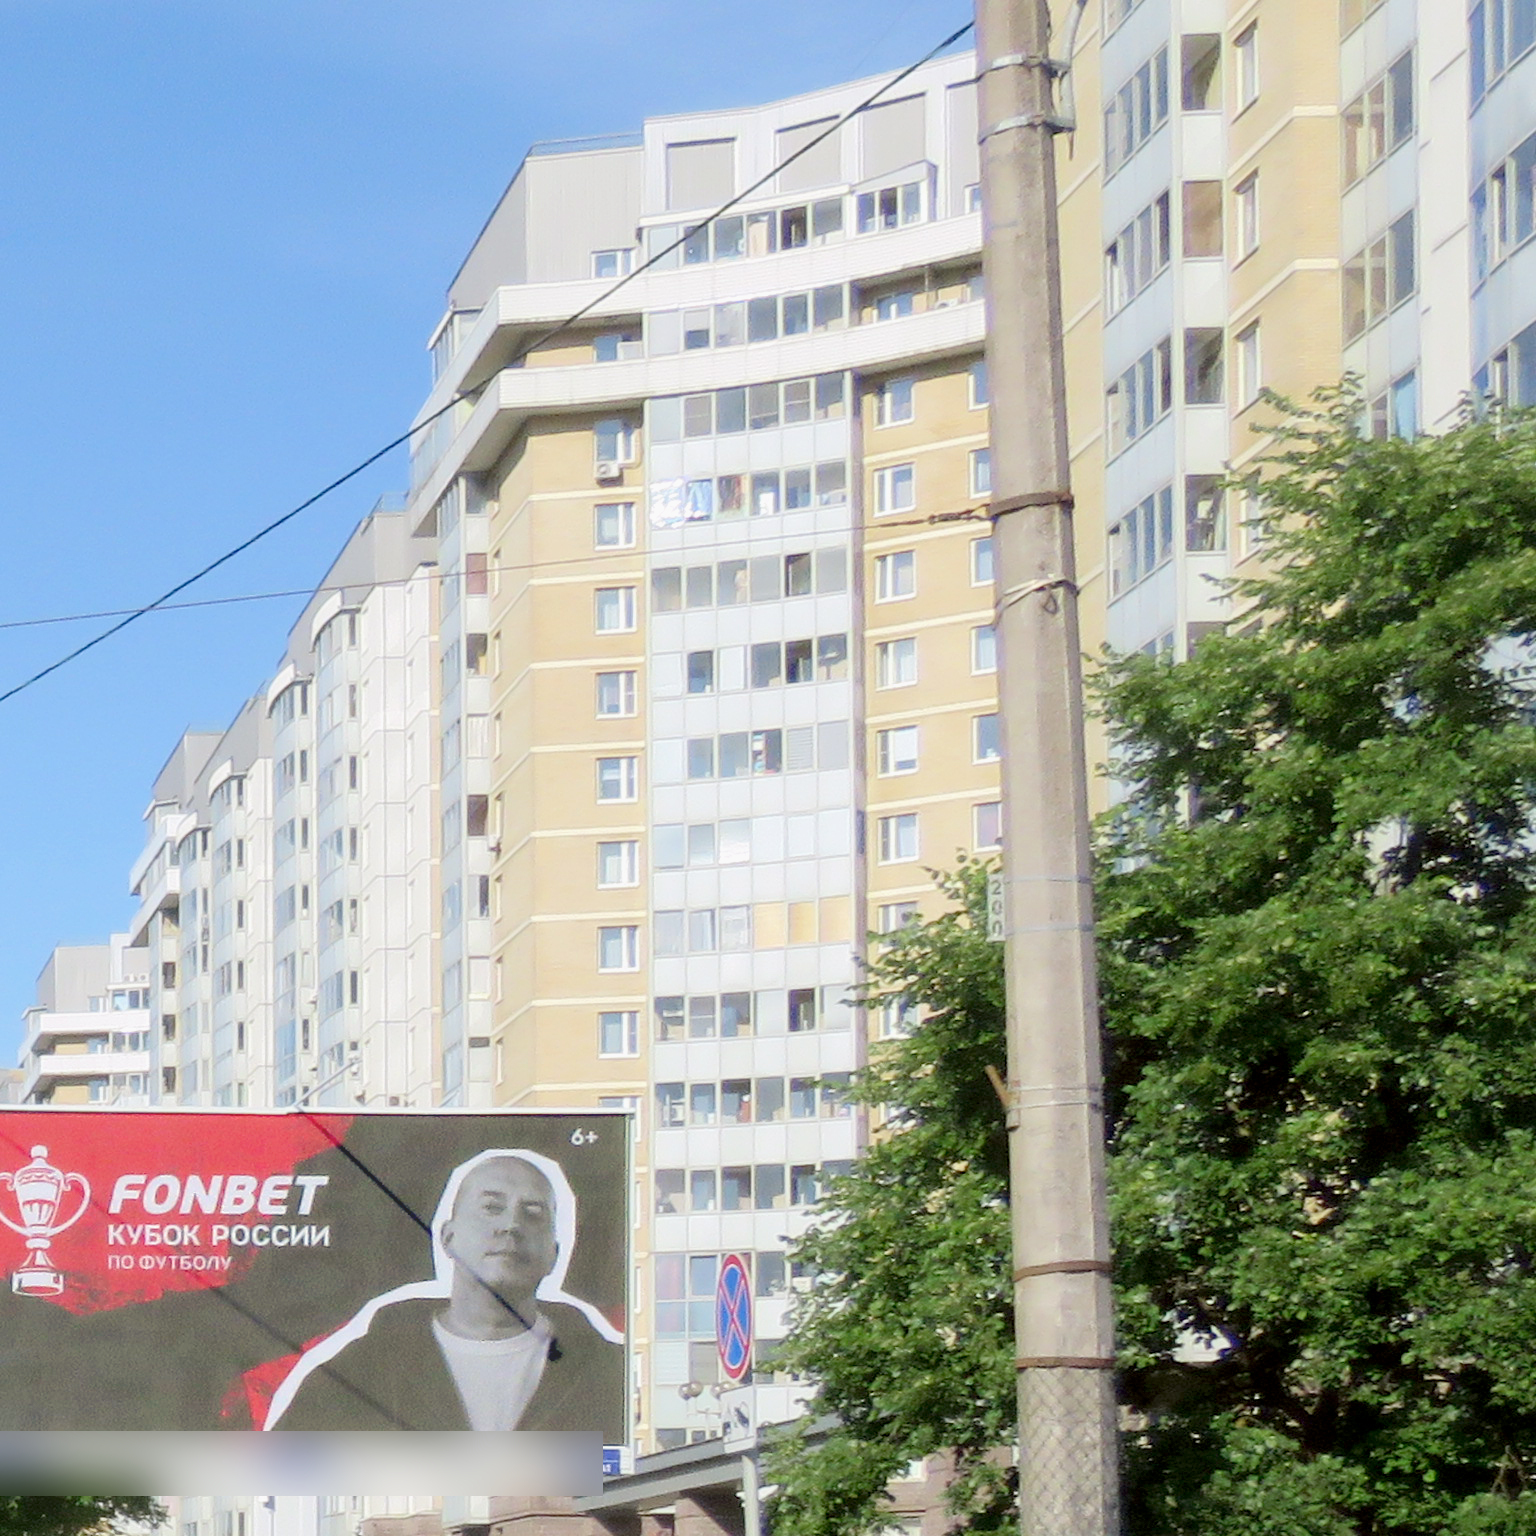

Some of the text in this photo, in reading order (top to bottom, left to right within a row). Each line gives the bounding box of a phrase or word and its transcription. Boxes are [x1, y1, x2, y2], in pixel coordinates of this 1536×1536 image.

[571, 1128, 599, 1146] 6+
[108, 1174, 330, 1216] FONBET
[107, 1224, 330, 1247] КУБОК РОССИИ
[107, 1254, 232, 1271] ПО ФУТБОЛУ
